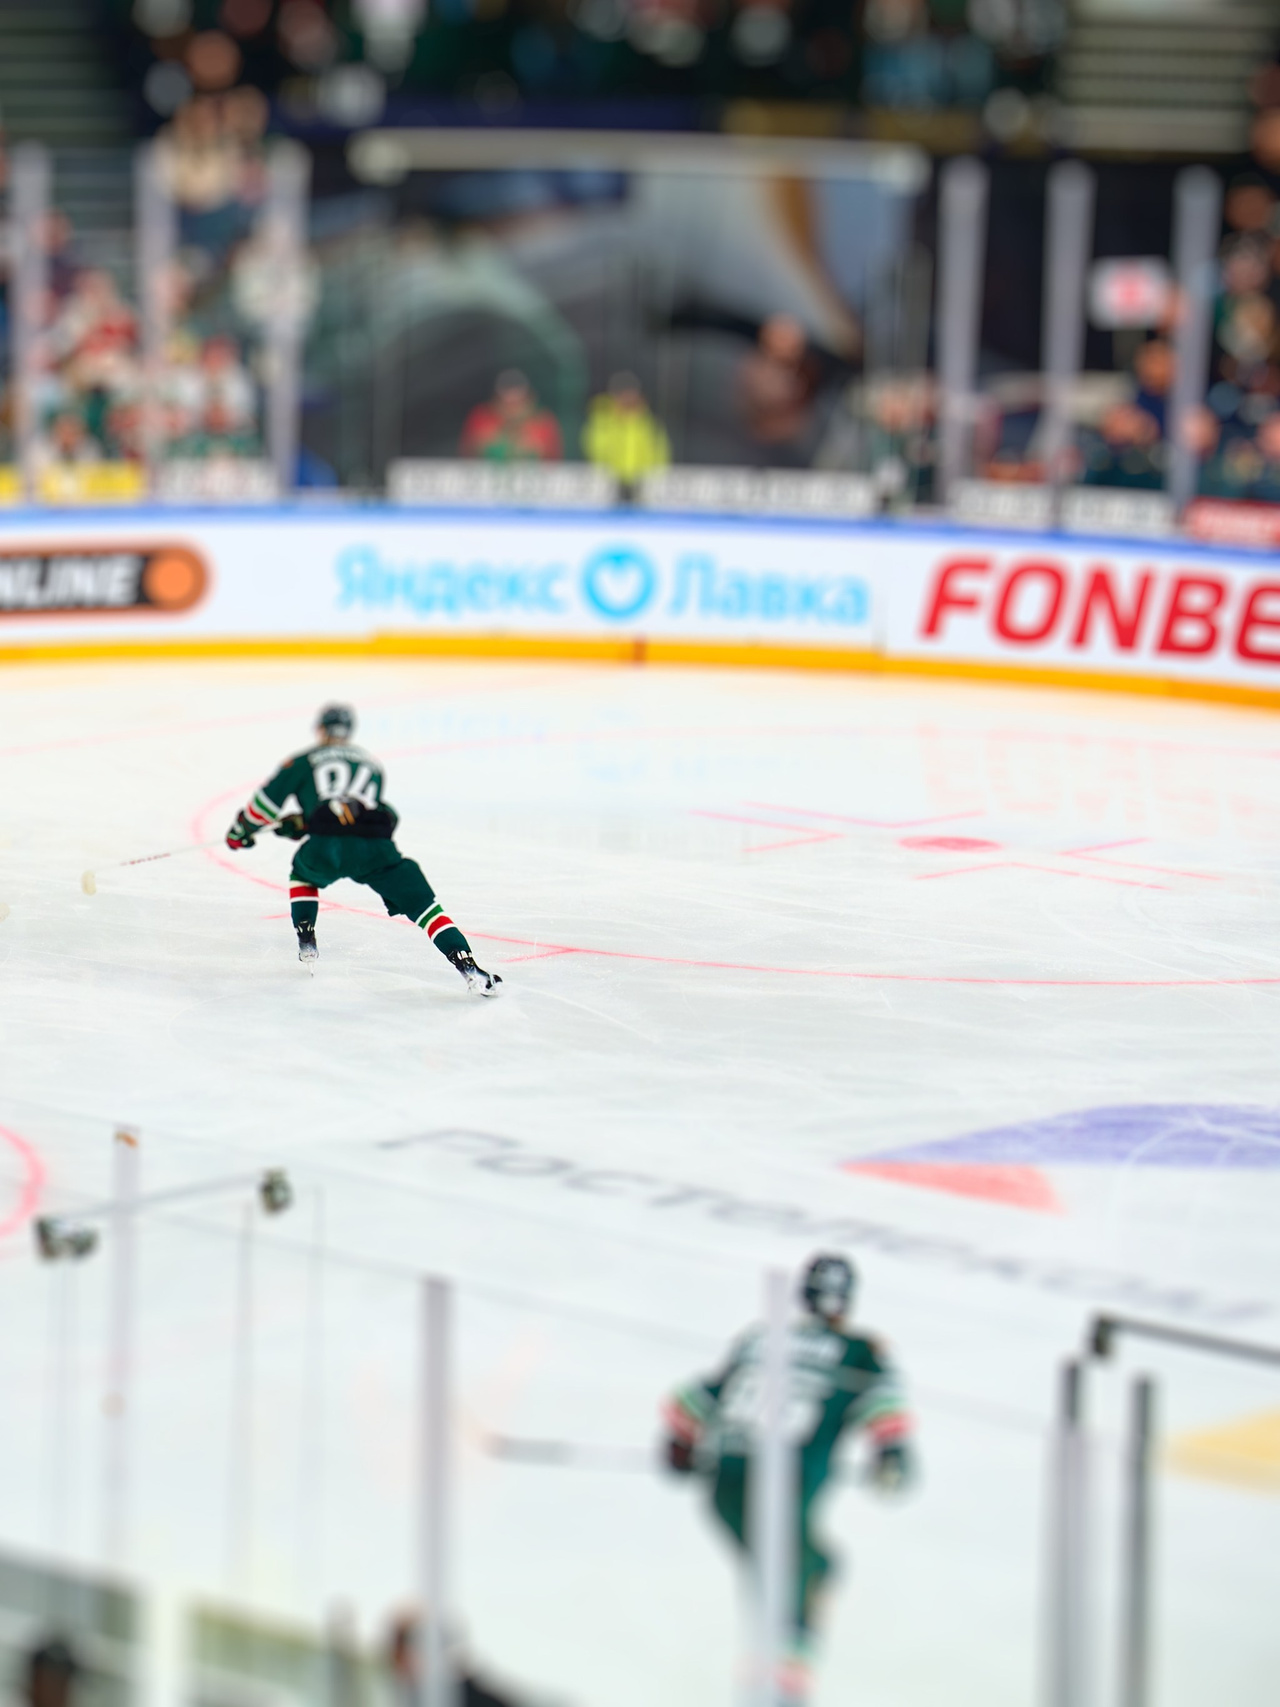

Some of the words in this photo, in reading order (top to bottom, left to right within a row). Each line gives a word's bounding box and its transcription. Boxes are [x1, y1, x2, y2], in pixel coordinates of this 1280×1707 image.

[335, 543, 570, 618] Яндекс
[670, 552, 871, 625] Лавка
[920, 554, 1280, 665] FONBE
